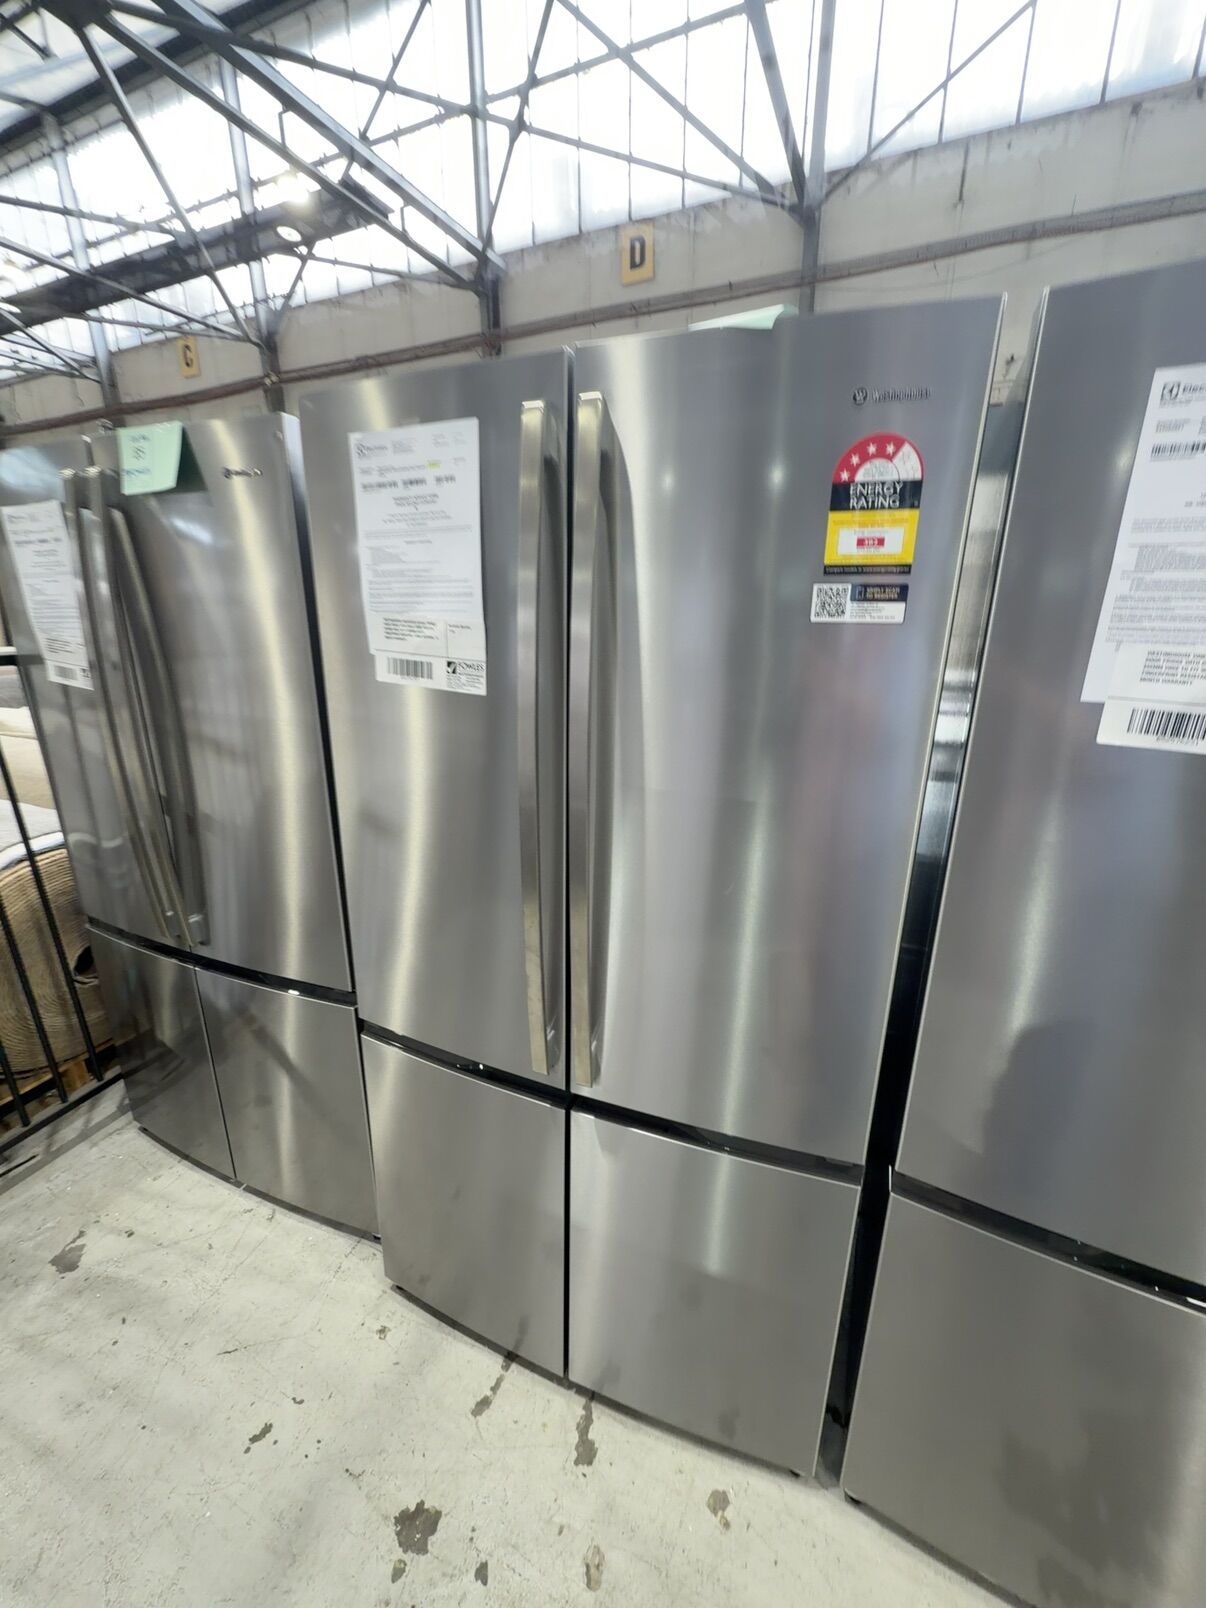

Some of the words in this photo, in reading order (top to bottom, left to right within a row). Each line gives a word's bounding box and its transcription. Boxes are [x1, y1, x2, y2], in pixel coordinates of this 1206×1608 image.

[629, 234, 646, 270] D
[872, 387, 930, 403] Westinghouse
[849, 481, 903, 496] ENERGY
[849, 495, 900, 510] RATING
